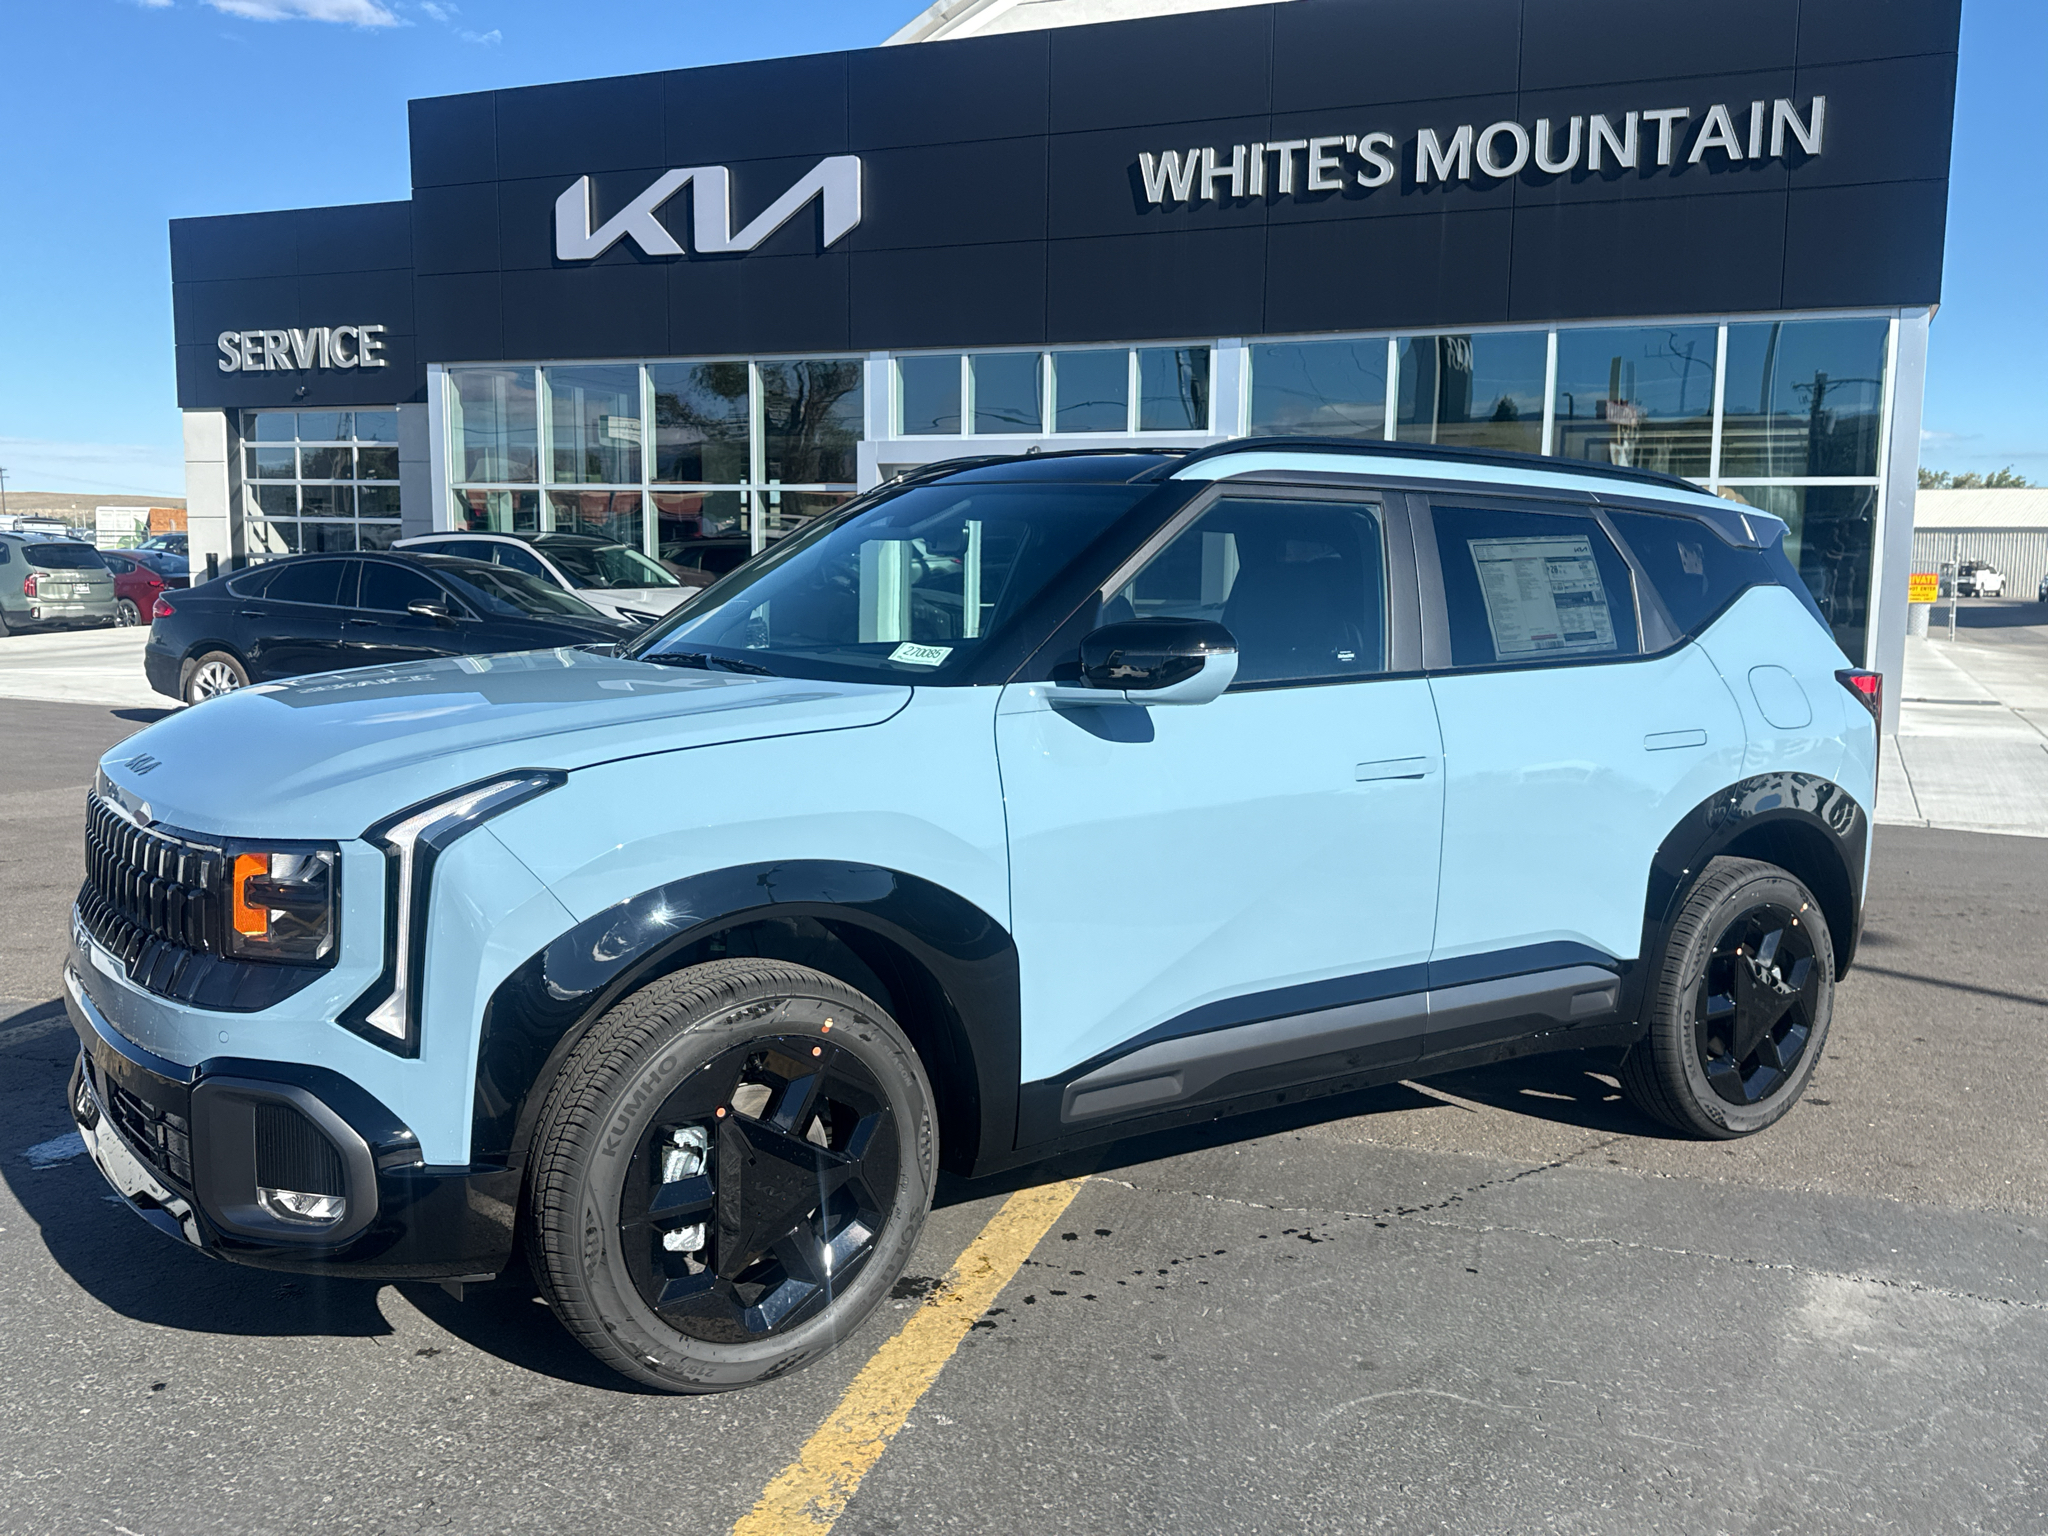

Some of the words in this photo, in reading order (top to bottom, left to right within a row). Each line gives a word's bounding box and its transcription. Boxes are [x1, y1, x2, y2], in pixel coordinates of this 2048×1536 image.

[1138, 132, 1395, 203] WHITE'S
[1416, 96, 1827, 183] MOUNTAIN
[555, 155, 862, 261] KIA
[217, 324, 386, 373] SERVICE
[1909, 575, 1937, 585] IVATE
[903, 646, 943, 659] 270085
[602, 1055, 677, 1157] KUMHO
